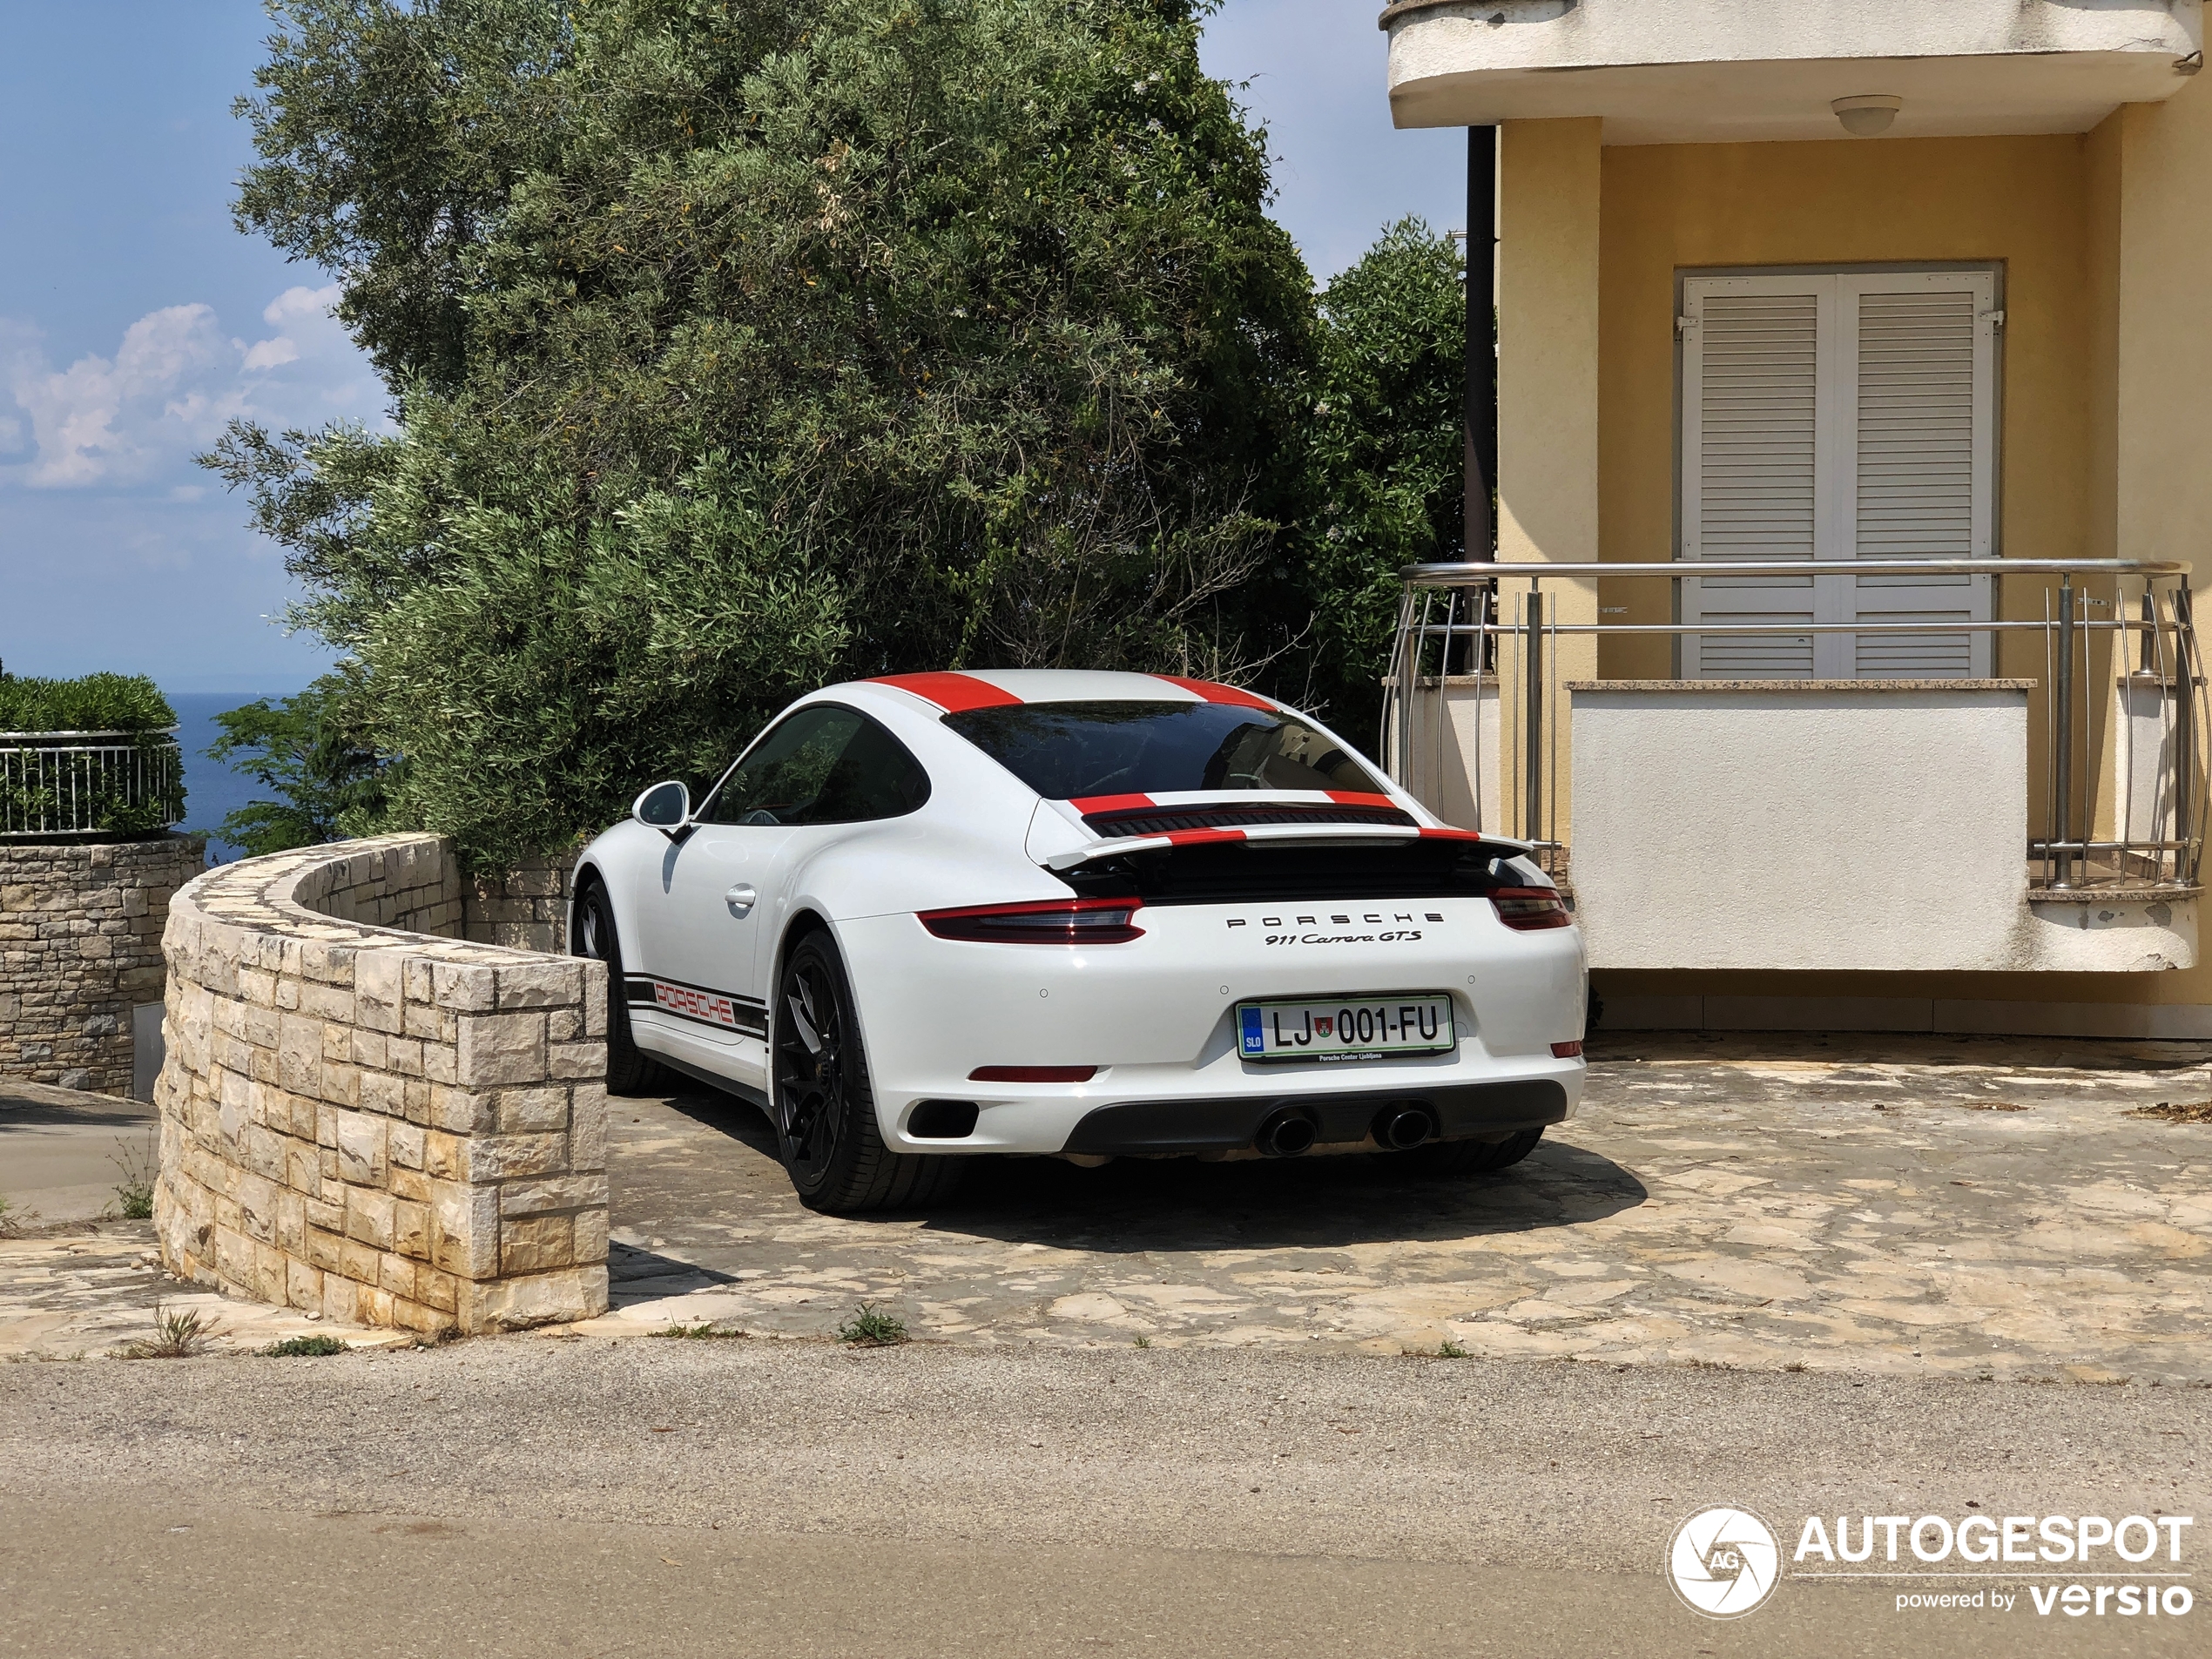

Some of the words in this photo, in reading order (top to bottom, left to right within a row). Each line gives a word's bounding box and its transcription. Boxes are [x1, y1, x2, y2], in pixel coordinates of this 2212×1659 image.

[1226, 913, 1445, 928] PORSCHE
[1264, 934, 1298, 945] 911
[1300, 934, 1375, 944] Carrera
[1379, 931, 1423, 942] GTS
[655, 983, 733, 1023] PORSCHE
[1272, 1010, 1312, 1047] LJ
[1338, 1005, 1438, 1044] 001-FU
[1245, 1036, 1262, 1048] SLO
[1359, 1052, 1382, 1061] Ljubljana
